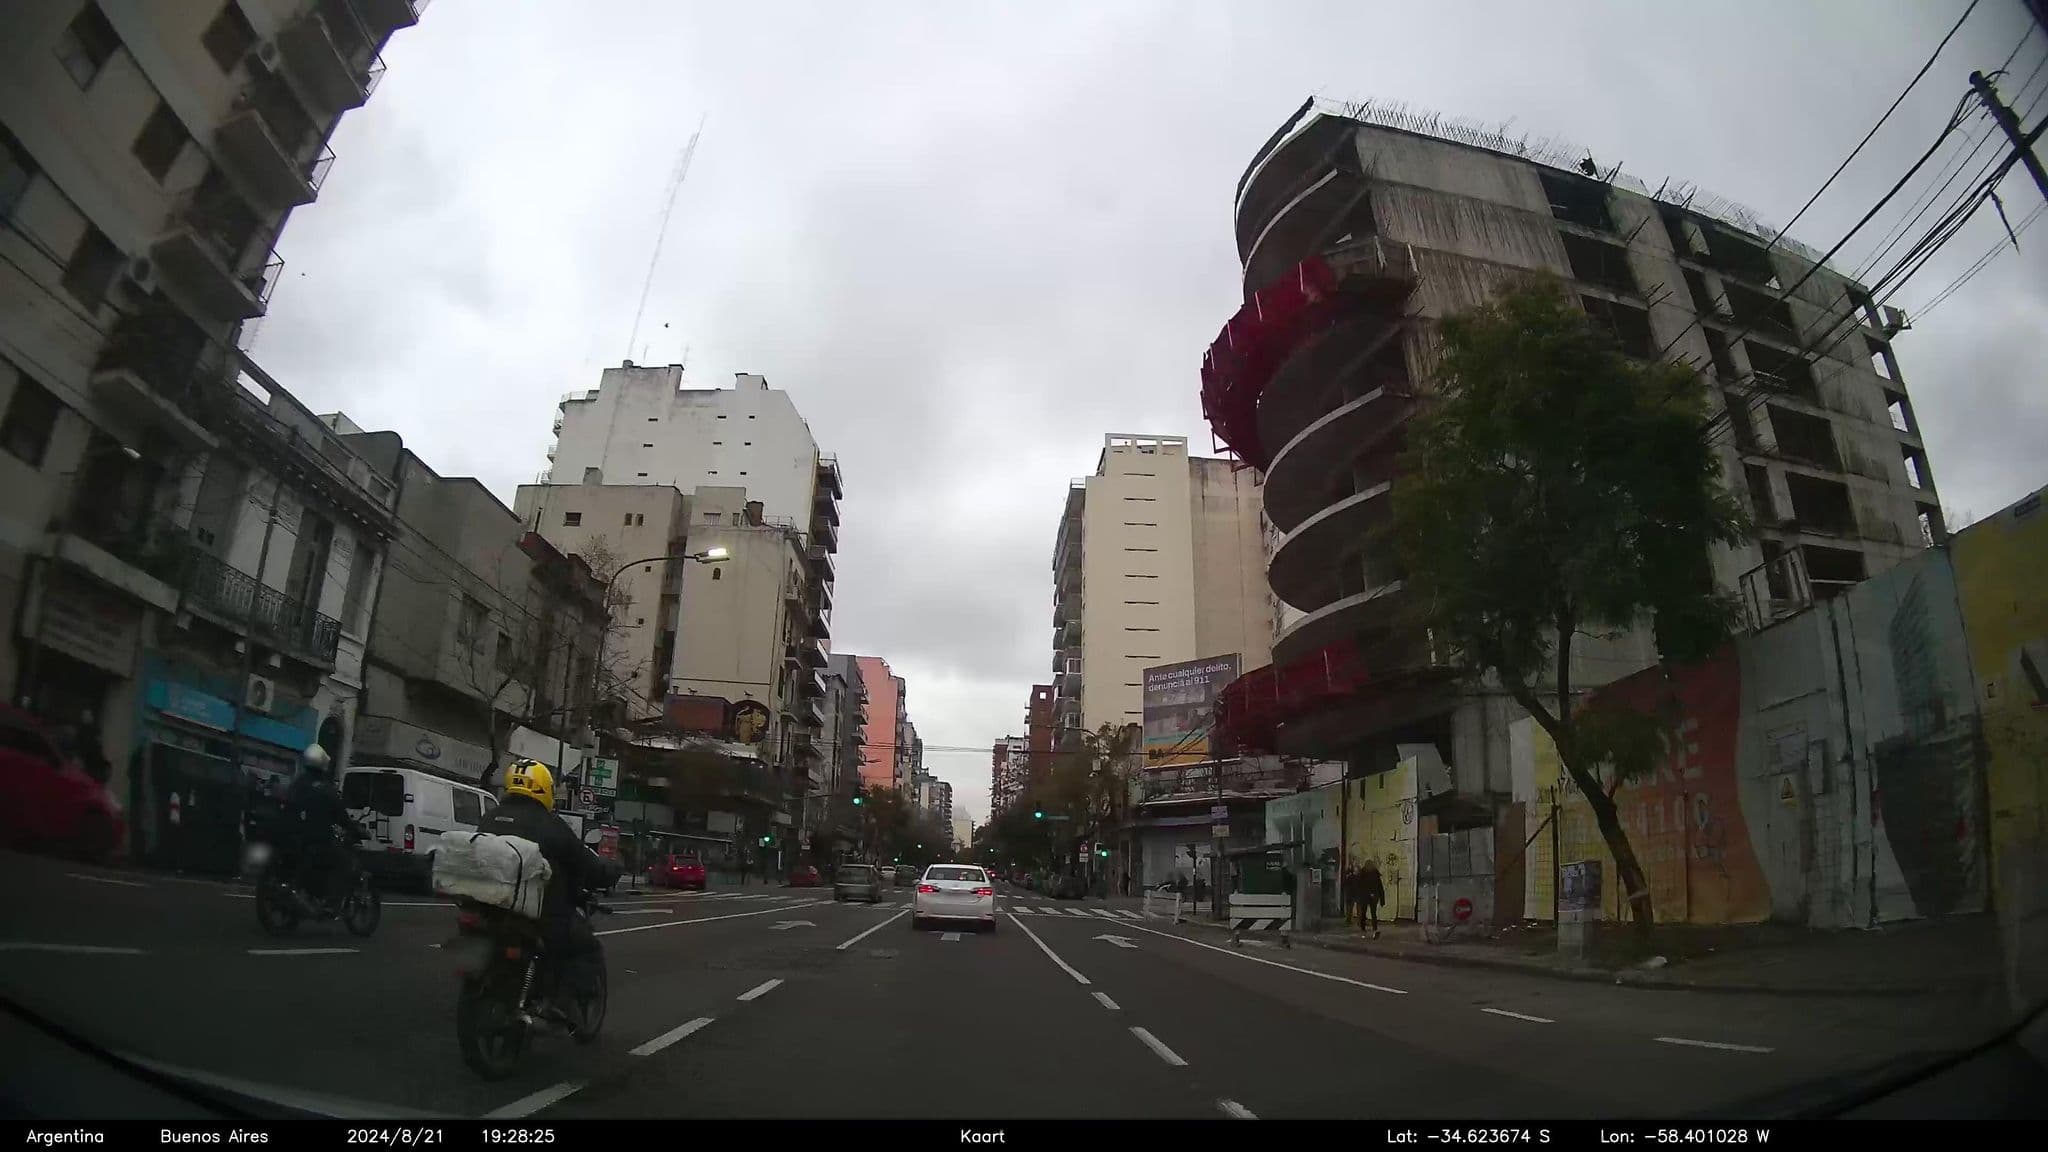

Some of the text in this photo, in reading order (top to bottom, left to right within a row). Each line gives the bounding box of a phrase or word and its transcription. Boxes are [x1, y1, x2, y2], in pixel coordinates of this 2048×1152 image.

[1148, 663, 1232, 682] Ante cualquier delito,
[1185, 677, 1193, 686] al
[1194, 675, 1210, 684] 911
